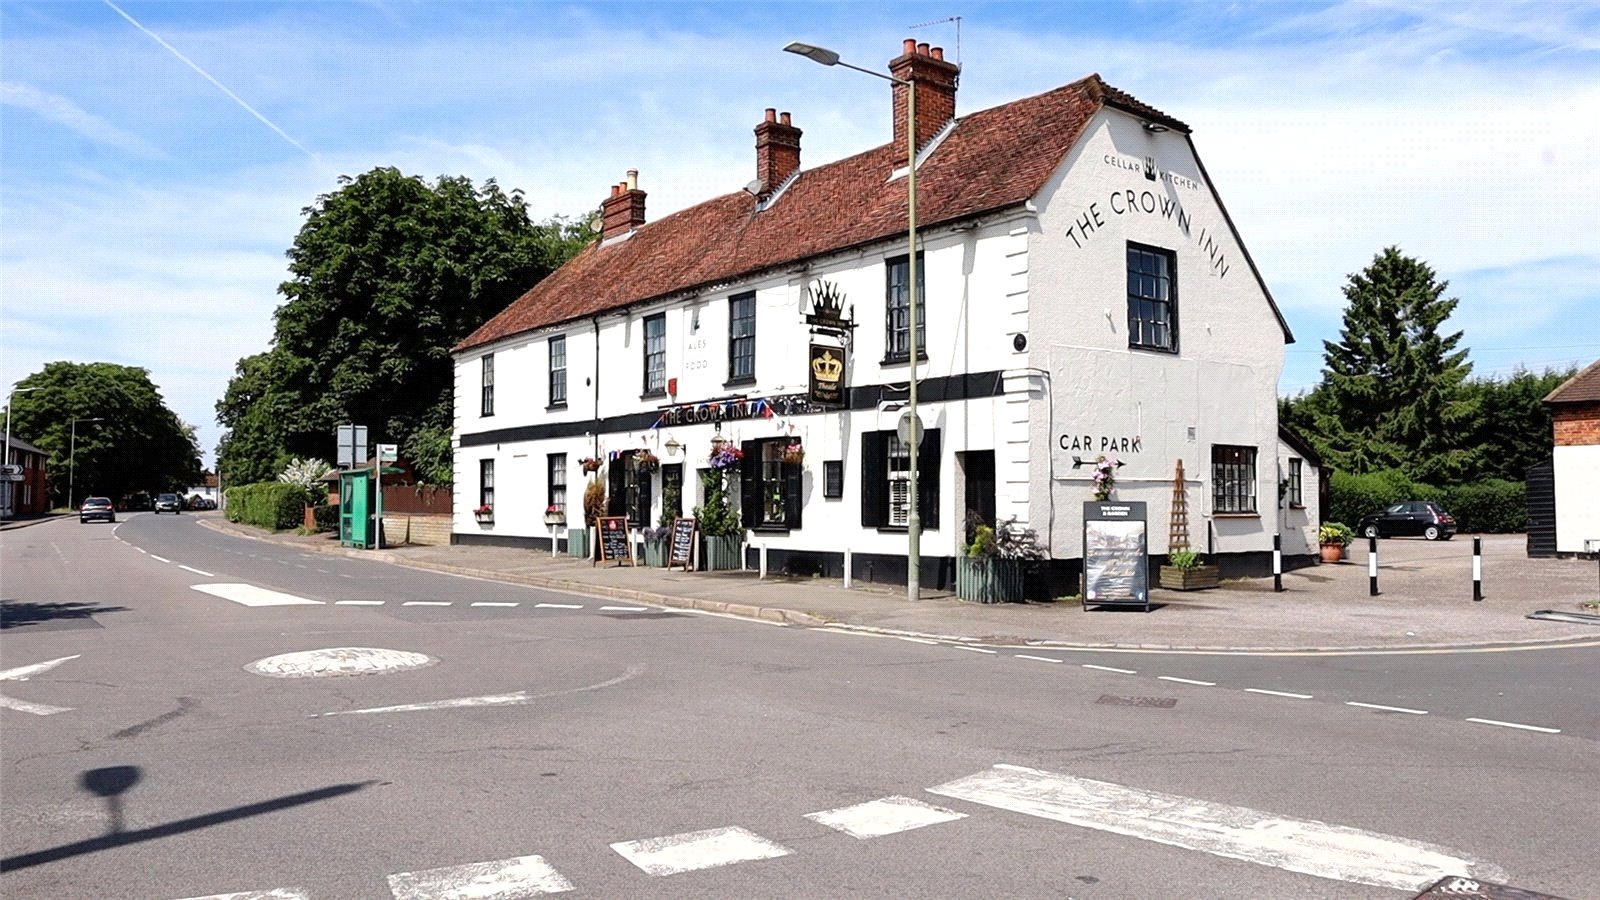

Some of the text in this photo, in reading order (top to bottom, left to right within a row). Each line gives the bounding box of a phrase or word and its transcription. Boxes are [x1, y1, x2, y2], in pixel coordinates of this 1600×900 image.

[1103, 154, 1198, 191] CELLAR KITCHEN
[1065, 189, 1230, 279] THE CROWN INN
[688, 339, 706, 351] ALES
[664, 408, 682, 425] THE
[1059, 434, 1140, 453] CAR PARK
